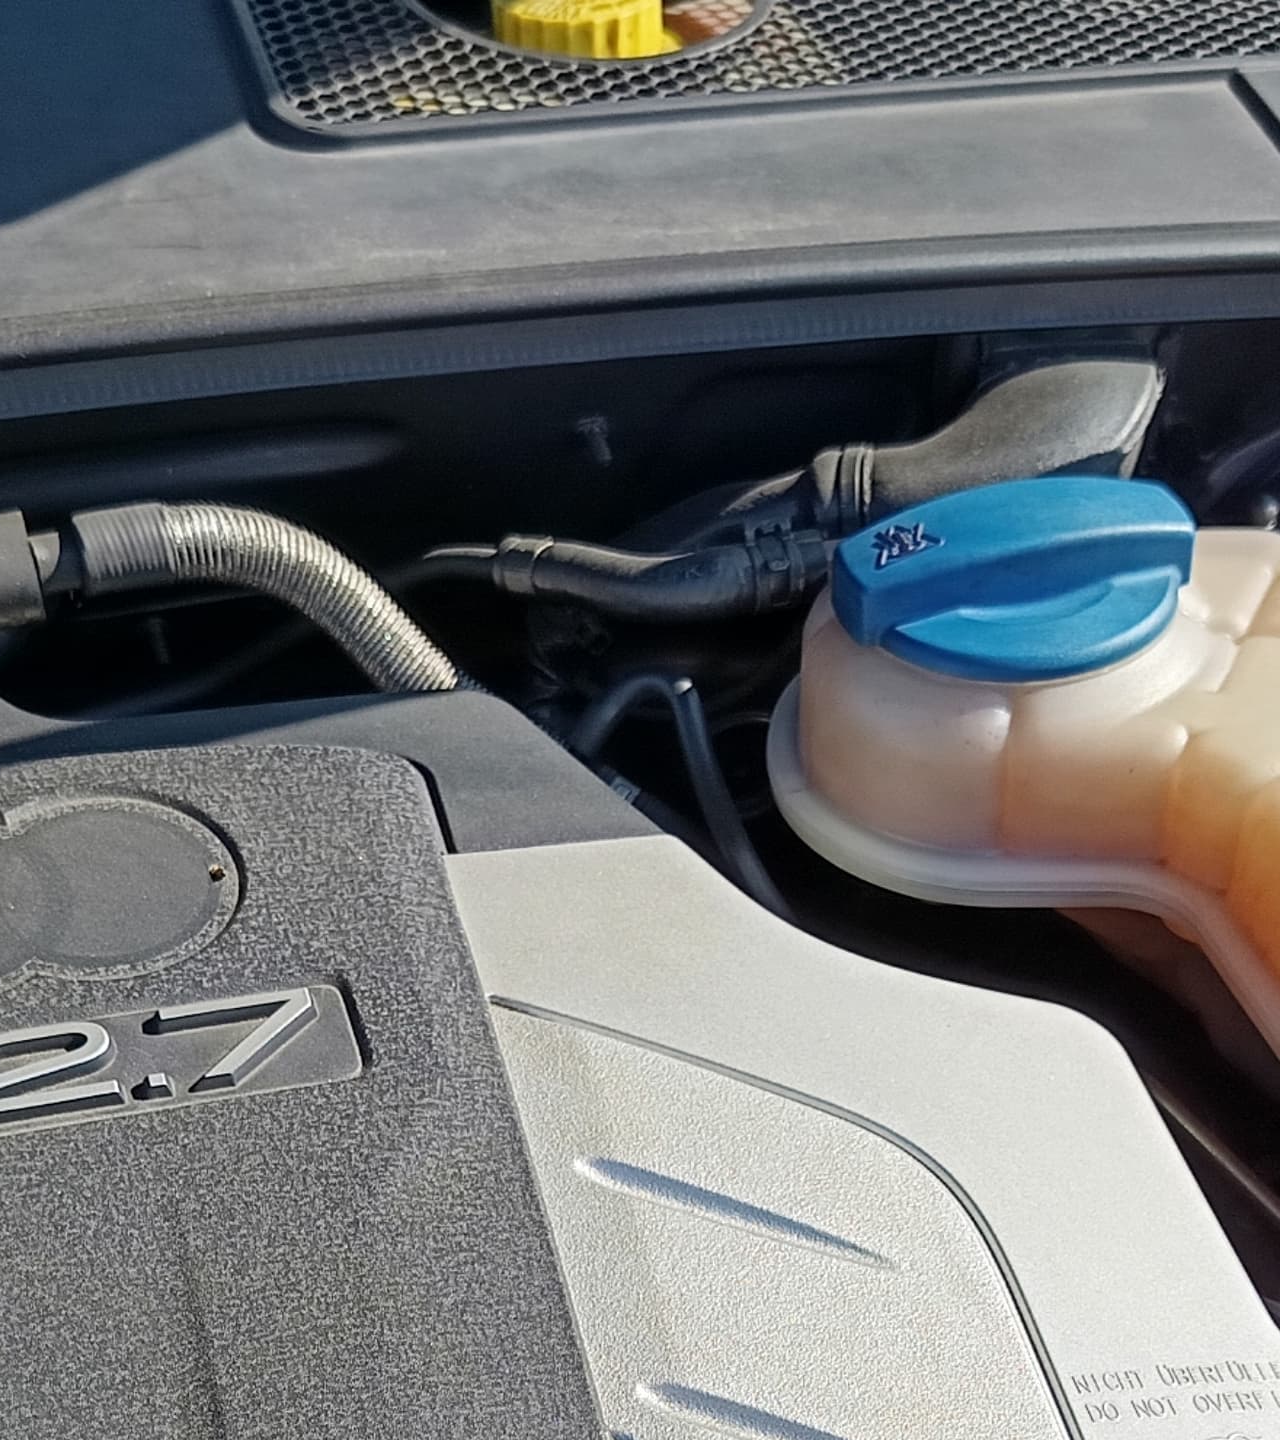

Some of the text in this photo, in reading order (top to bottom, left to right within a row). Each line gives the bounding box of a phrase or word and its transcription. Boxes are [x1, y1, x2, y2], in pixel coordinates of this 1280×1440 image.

[1072, 1369, 1144, 1394] NICHT
[1084, 1402, 1119, 1423] DO
[1131, 1396, 1177, 1419] NOT
